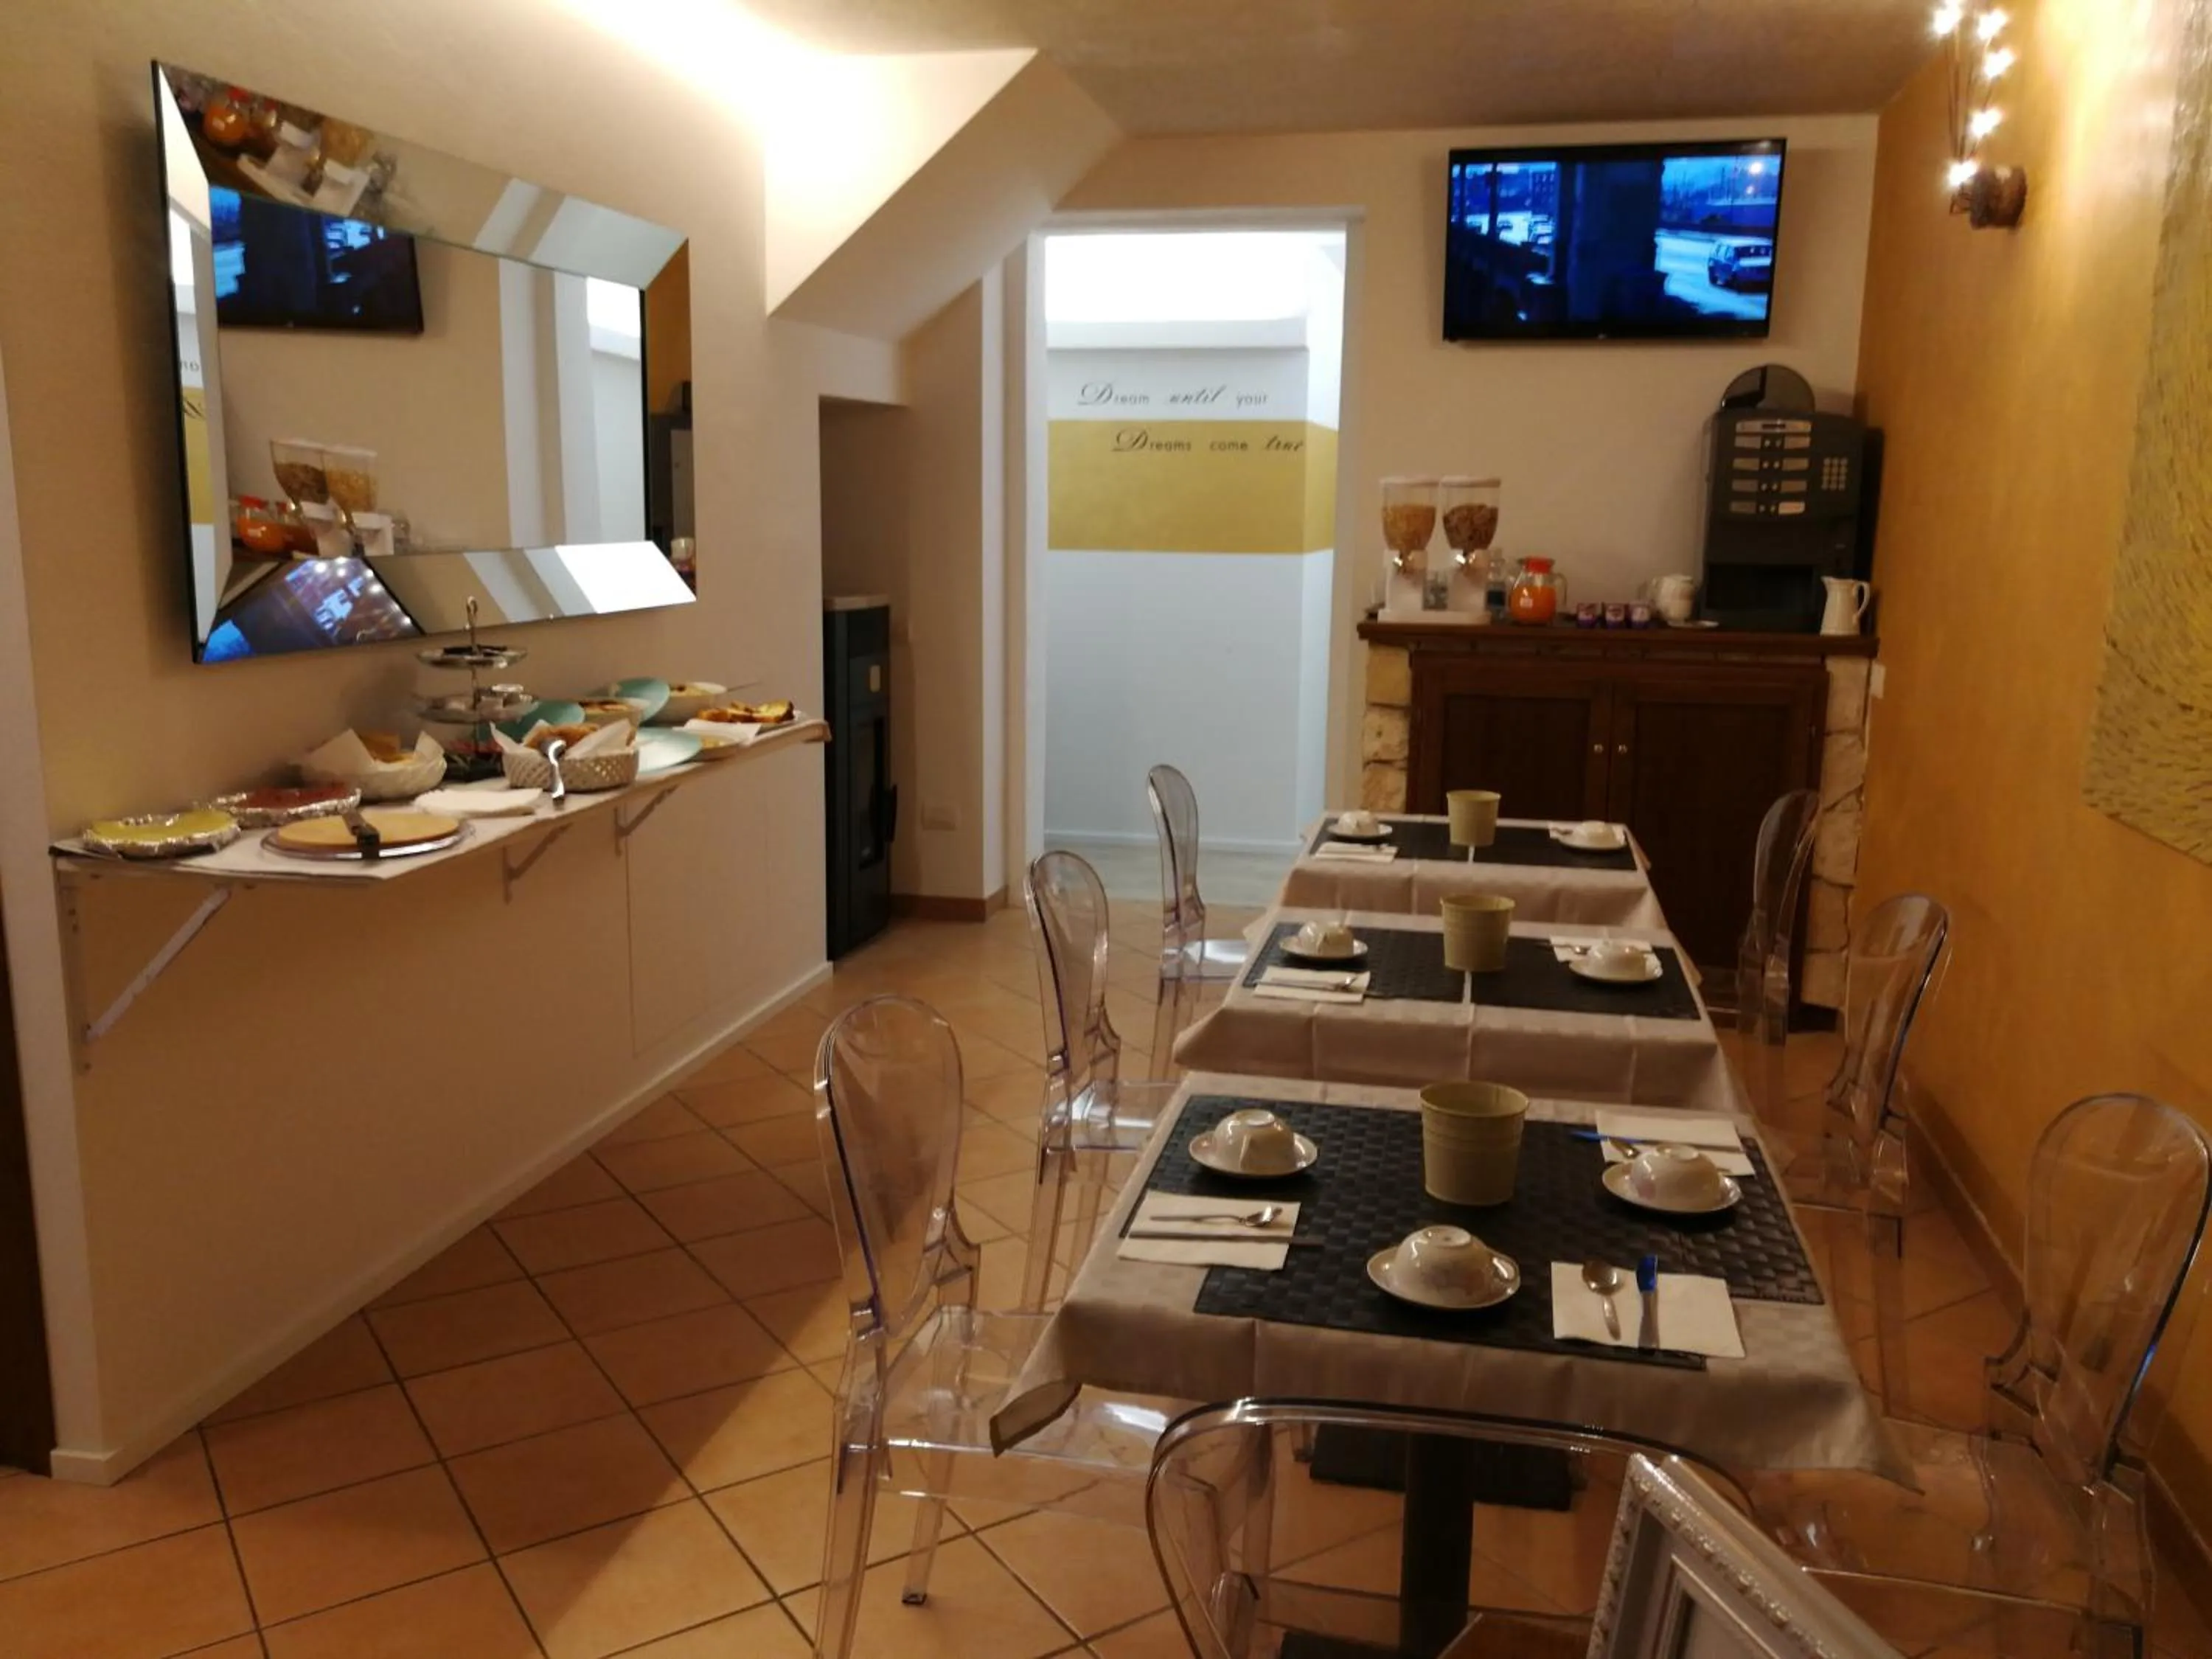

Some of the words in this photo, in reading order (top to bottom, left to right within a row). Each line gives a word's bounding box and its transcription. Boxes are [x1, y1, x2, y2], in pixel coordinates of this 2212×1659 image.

[1078, 380, 1150, 406] Dream
[1169, 384, 1227, 404] until
[1235, 394, 1268, 408] your
[1111, 428, 1192, 452] Dreams
[1209, 439, 1248, 451] come
